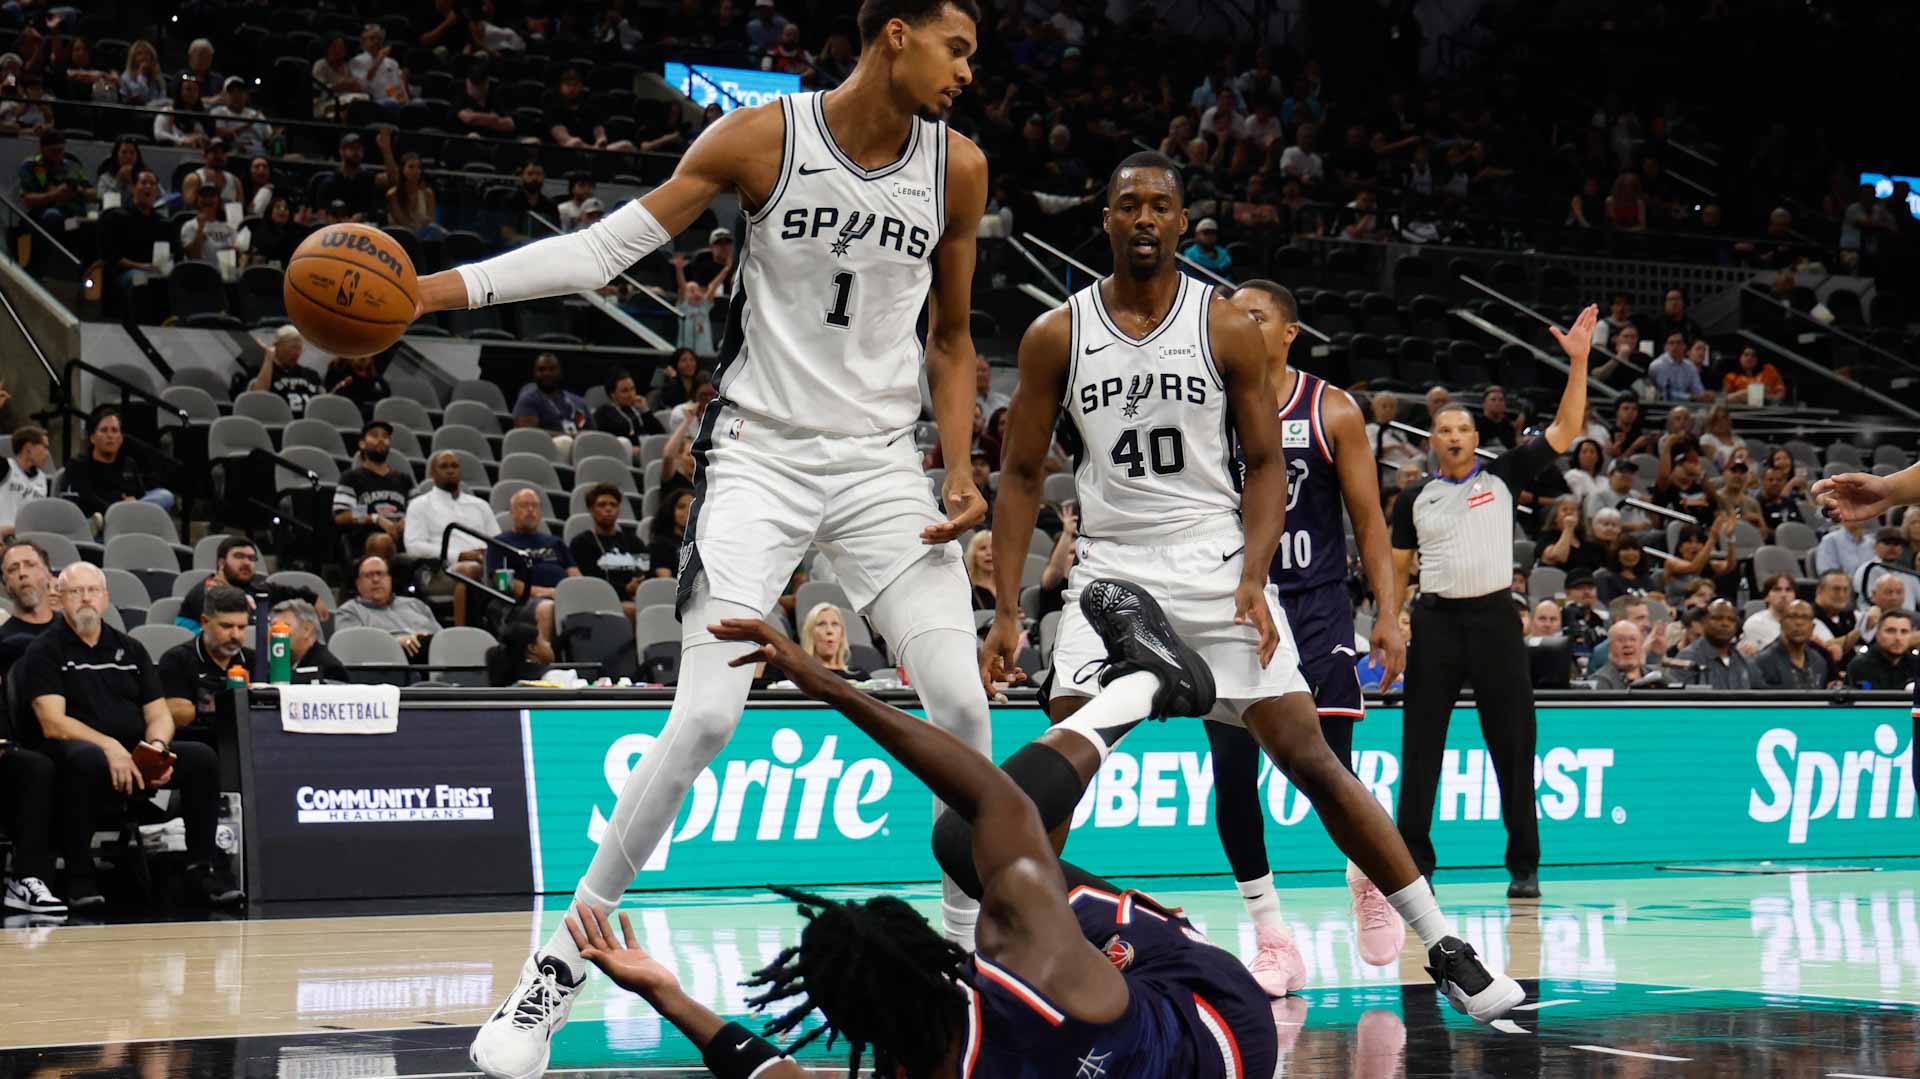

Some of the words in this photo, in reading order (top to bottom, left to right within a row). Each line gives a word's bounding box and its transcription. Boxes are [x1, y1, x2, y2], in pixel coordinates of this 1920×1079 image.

[897, 186, 926, 198] LEDGER
[321, 231, 402, 278] Wilson
[781, 207, 930, 259] SPURS
[823, 269, 856, 329] 1
[1163, 348, 1192, 356] LEDGER
[1080, 373, 1207, 419] SPURS
[1109, 425, 1186, 479] 40
[1280, 529, 1312, 570] 10
[272, 642, 285, 657] G
[302, 701, 389, 721] BASKETBALL
[297, 786, 431, 810] COMMUNITY
[435, 784, 493, 808] FIRST
[587, 727, 893, 872] Sprite
[1258, 747, 1399, 826] OR
[1748, 723, 1916, 844] Sprit
[329, 810, 398, 821] HEALTH
[409, 808, 465, 819] PLANS
